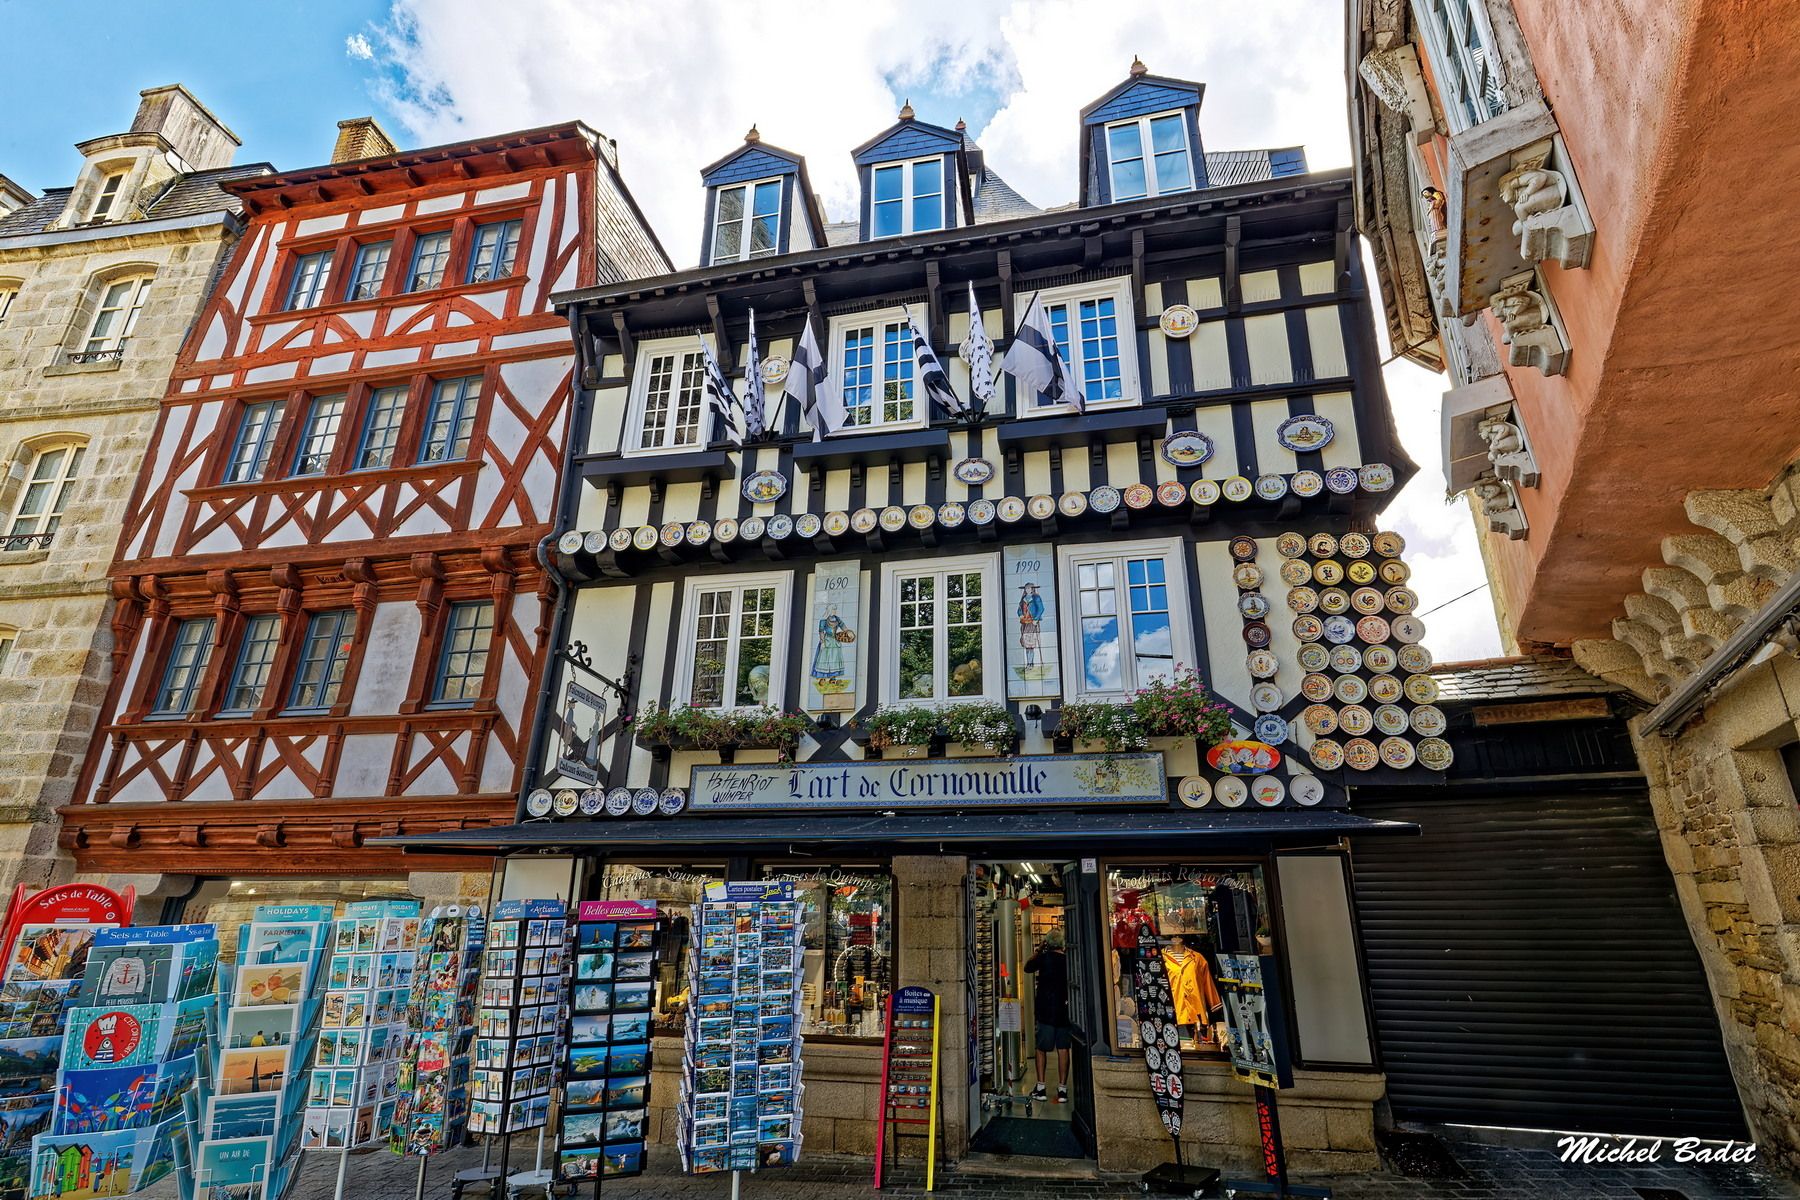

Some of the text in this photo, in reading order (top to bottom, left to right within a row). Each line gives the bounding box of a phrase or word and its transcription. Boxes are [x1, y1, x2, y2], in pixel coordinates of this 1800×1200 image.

[1015, 560, 1041, 574] 1990
[824, 576, 849, 591] 1690
[722, 771, 780, 792] HENRIOT
[788, 762, 1048, 799] L'art de Cornouaille
[712, 790, 754, 804] QUIMPER
[603, 869, 654, 889] Cadeaux
[830, 868, 883, 892] Quimper
[1116, 868, 1173, 891] Produits
[727, 885, 763, 894] Cartes postales
[40, 888, 113, 910] Sets de Table
[266, 907, 309, 915] HOLIDAYS
[584, 905, 638, 917] Belles images
[109, 930, 169, 940] Sets de Table
[263, 928, 306, 936] FARNIENTE
[903, 997, 928, 1005] musique
[219, 1151, 230, 1160] UN
